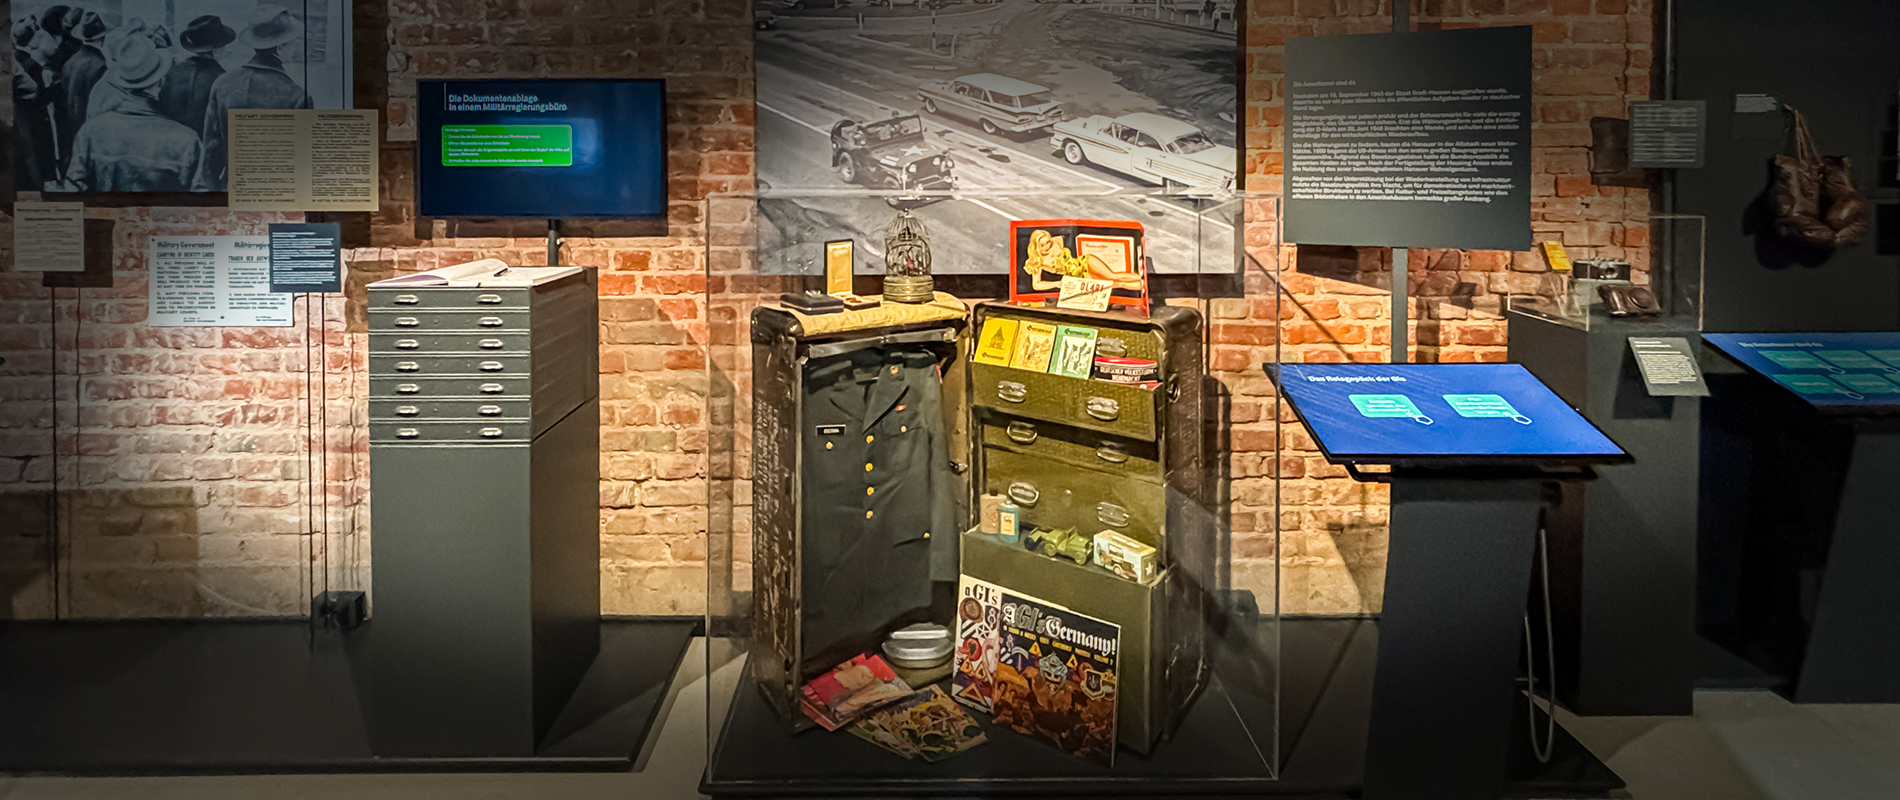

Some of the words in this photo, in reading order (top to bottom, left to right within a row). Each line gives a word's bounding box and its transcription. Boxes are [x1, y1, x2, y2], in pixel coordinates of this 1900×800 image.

[463, 94, 539, 104] Dokumentenablage
[483, 101, 568, 112] Militärregierungsbüro
[157, 241, 179, 249] Military
[972, 583, 998, 606] GI's
[1002, 603, 1017, 625] A
[1016, 604, 1046, 634] GI's
[1045, 615, 1117, 656] Germany!
